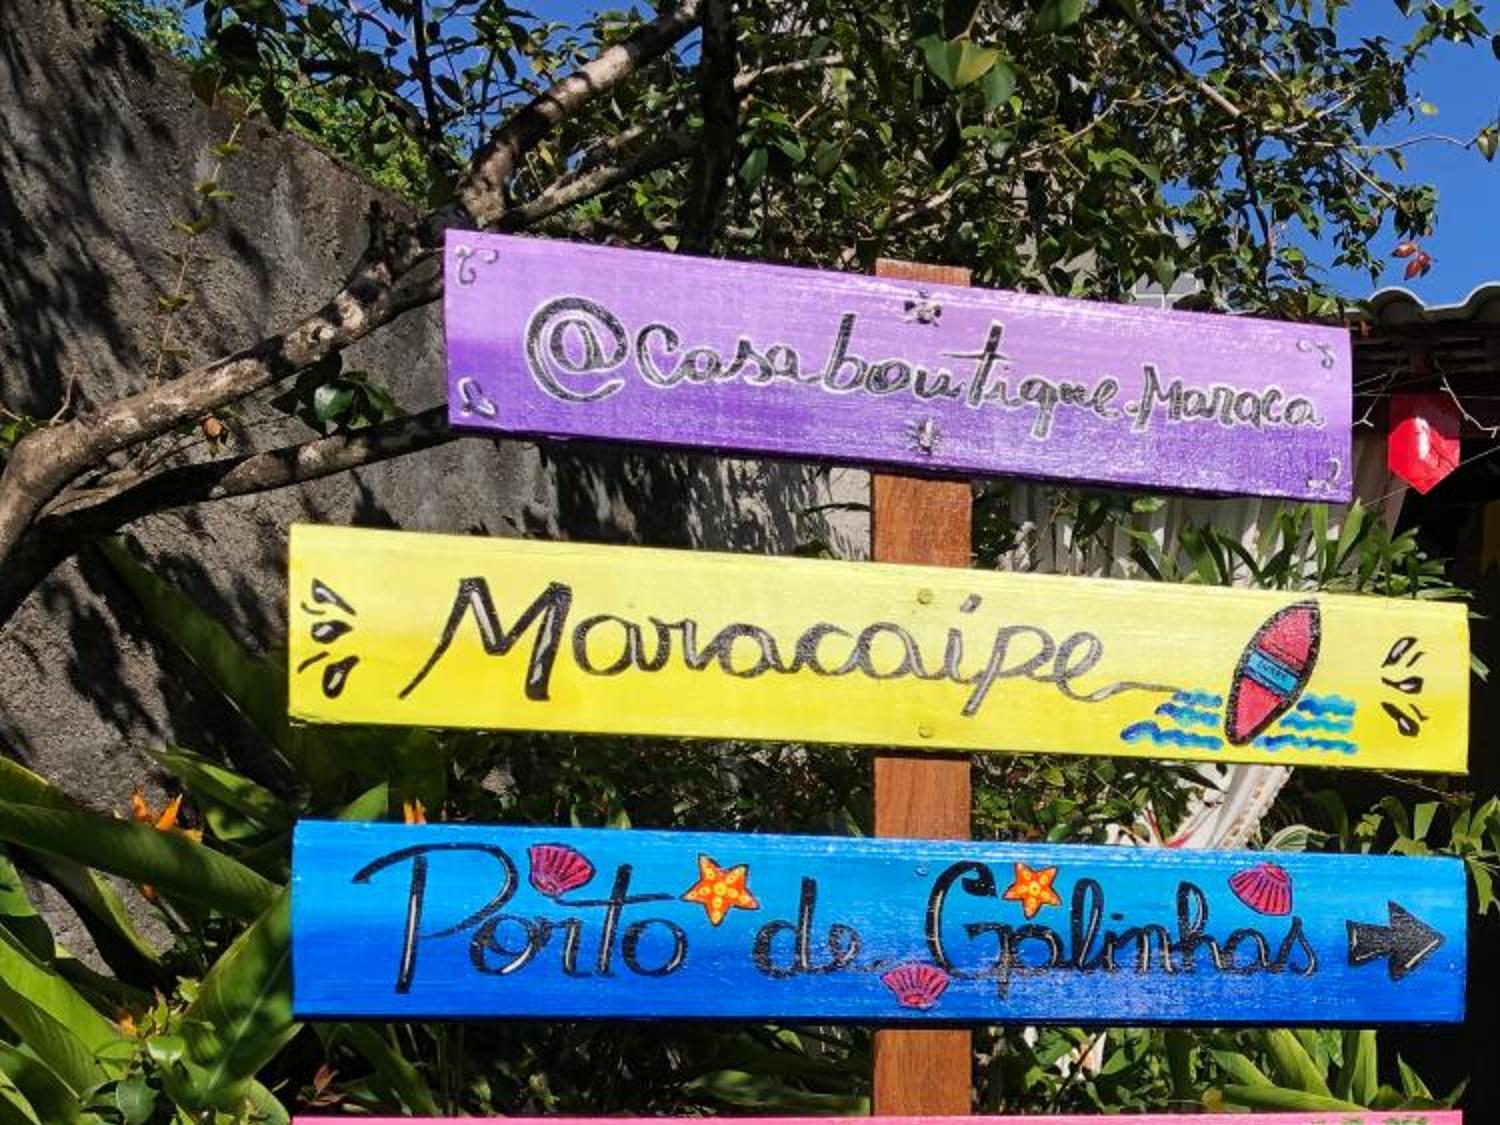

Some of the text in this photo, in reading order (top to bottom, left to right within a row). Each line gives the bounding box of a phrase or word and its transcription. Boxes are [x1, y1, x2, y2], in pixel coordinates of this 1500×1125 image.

[352, 842, 1318, 1000] Porto de Galinhas
